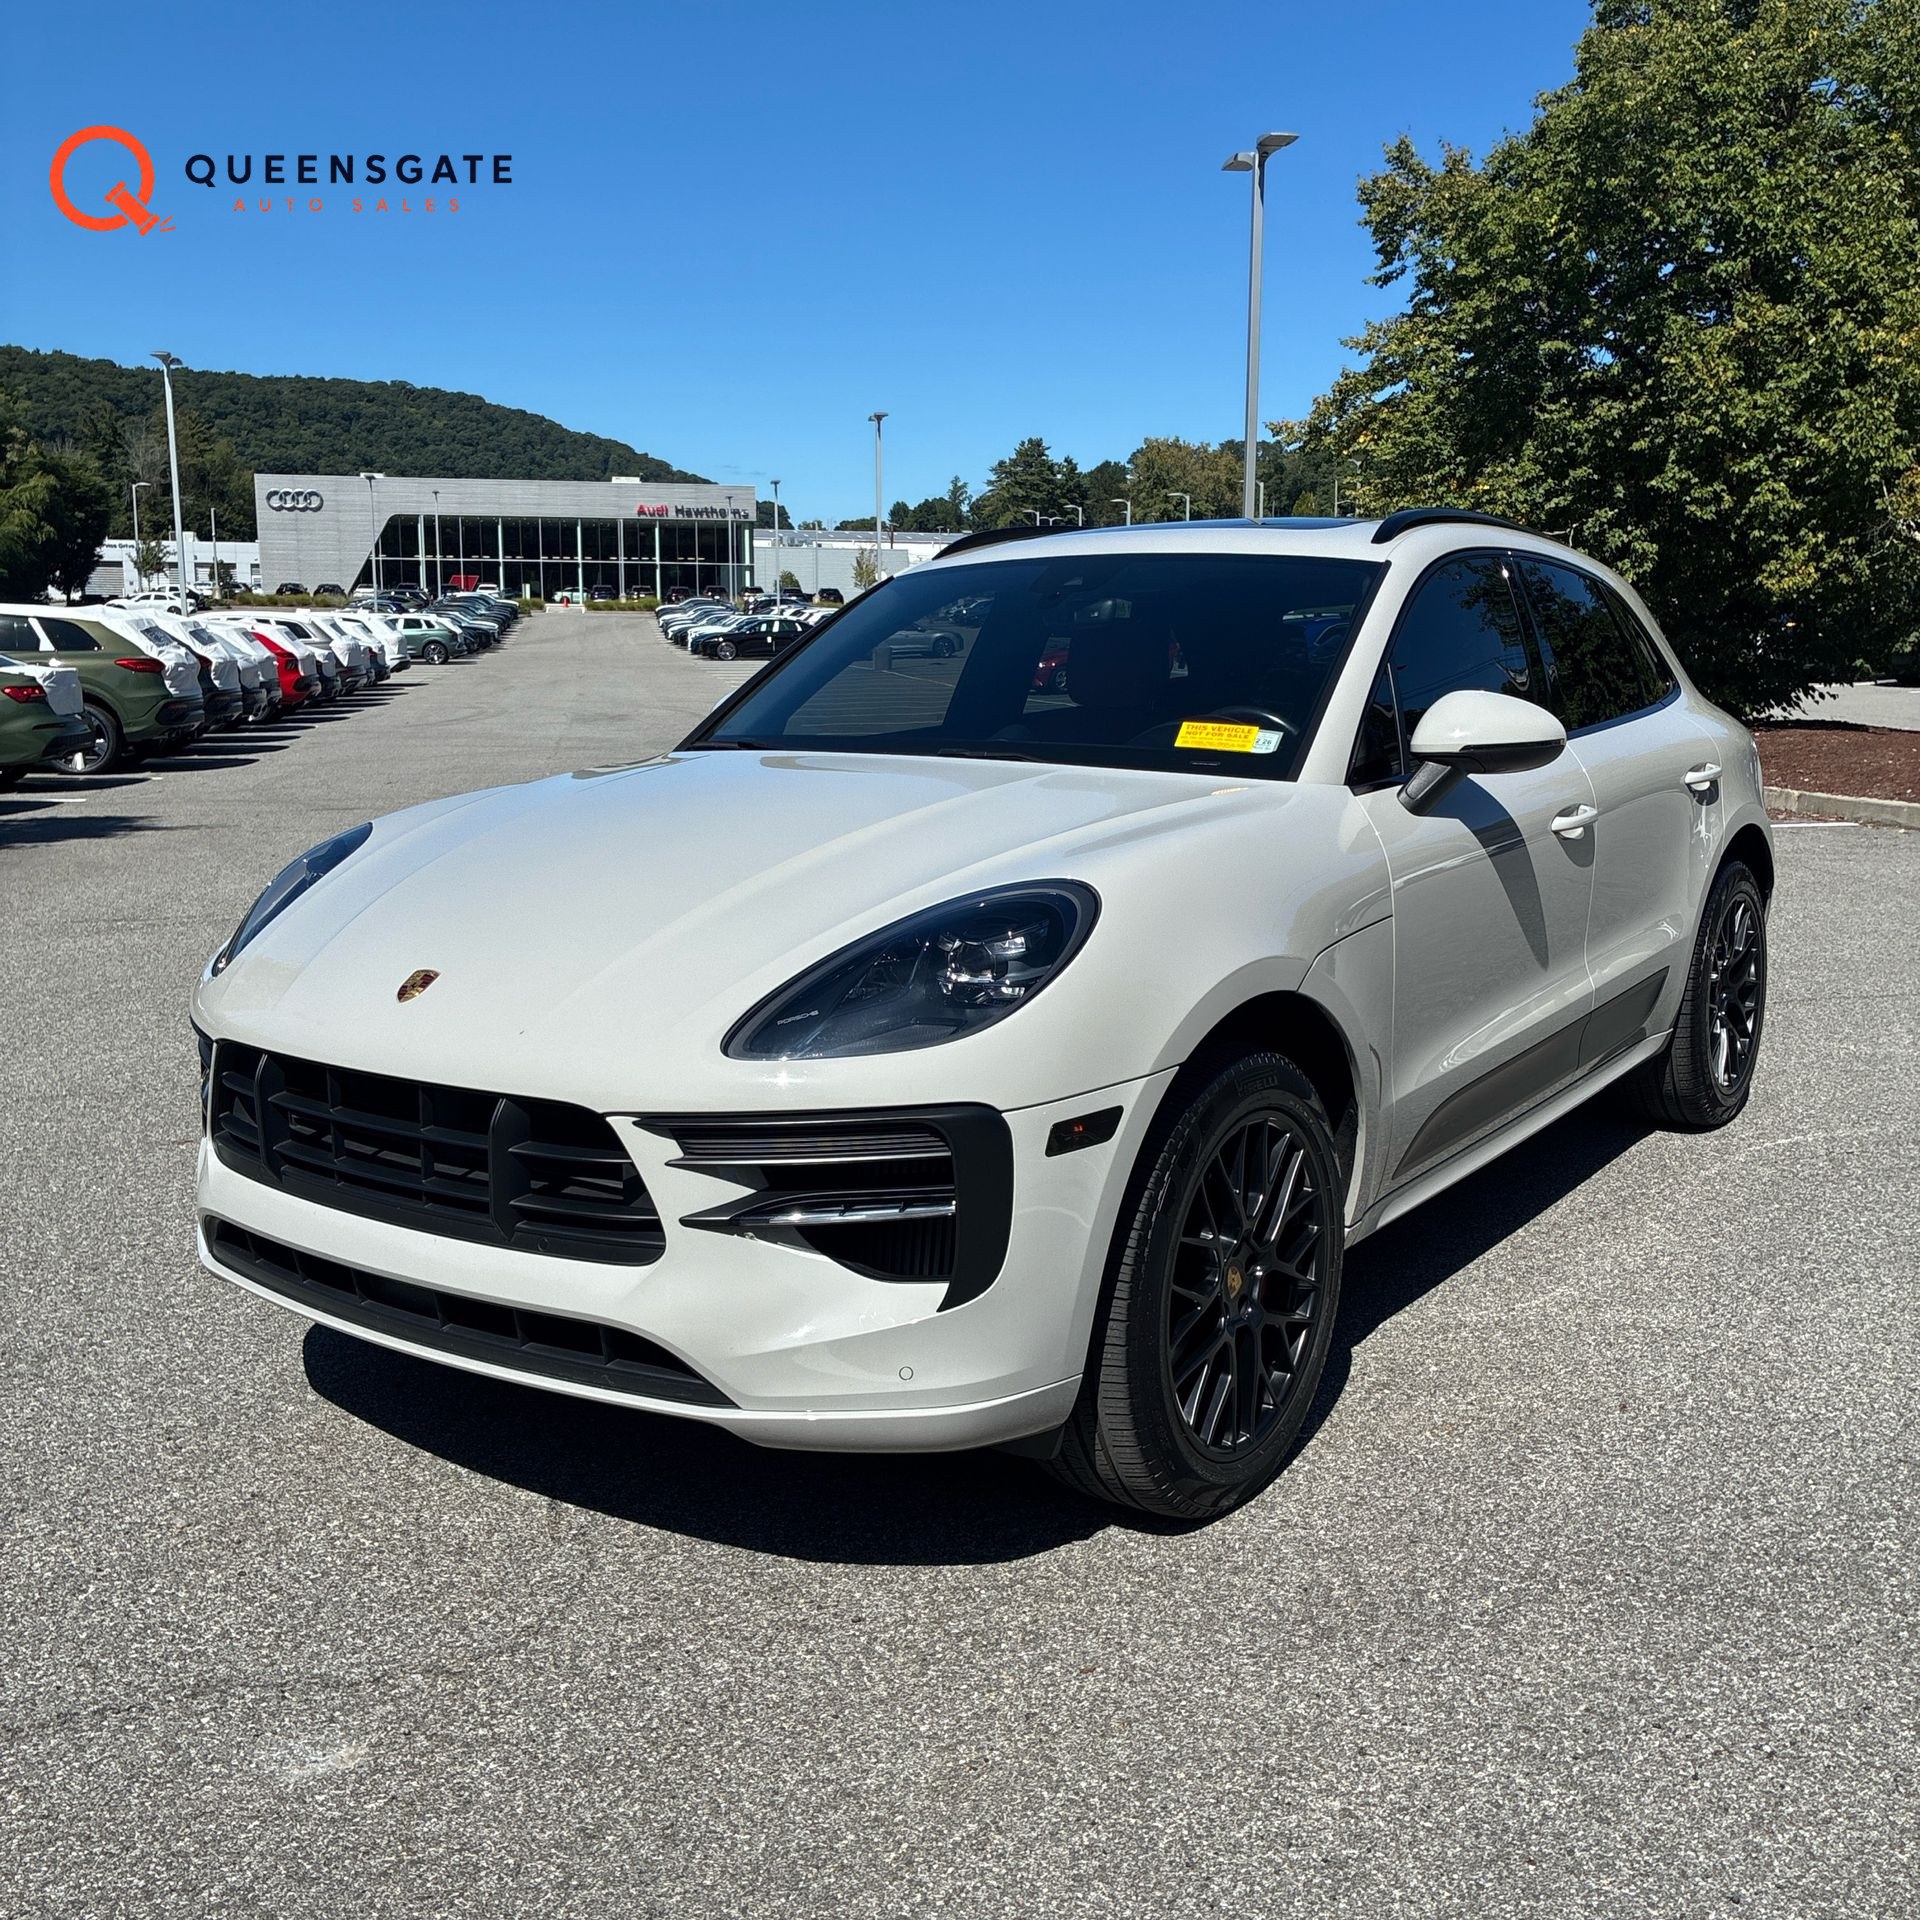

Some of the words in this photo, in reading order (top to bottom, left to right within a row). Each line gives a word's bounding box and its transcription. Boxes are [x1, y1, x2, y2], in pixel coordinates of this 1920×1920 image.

[637, 504, 669, 518] Audi
[1186, 724, 1208, 732] THIS
[1211, 725, 1254, 735] VEHICLE
[1227, 732, 1250, 740] SALE
